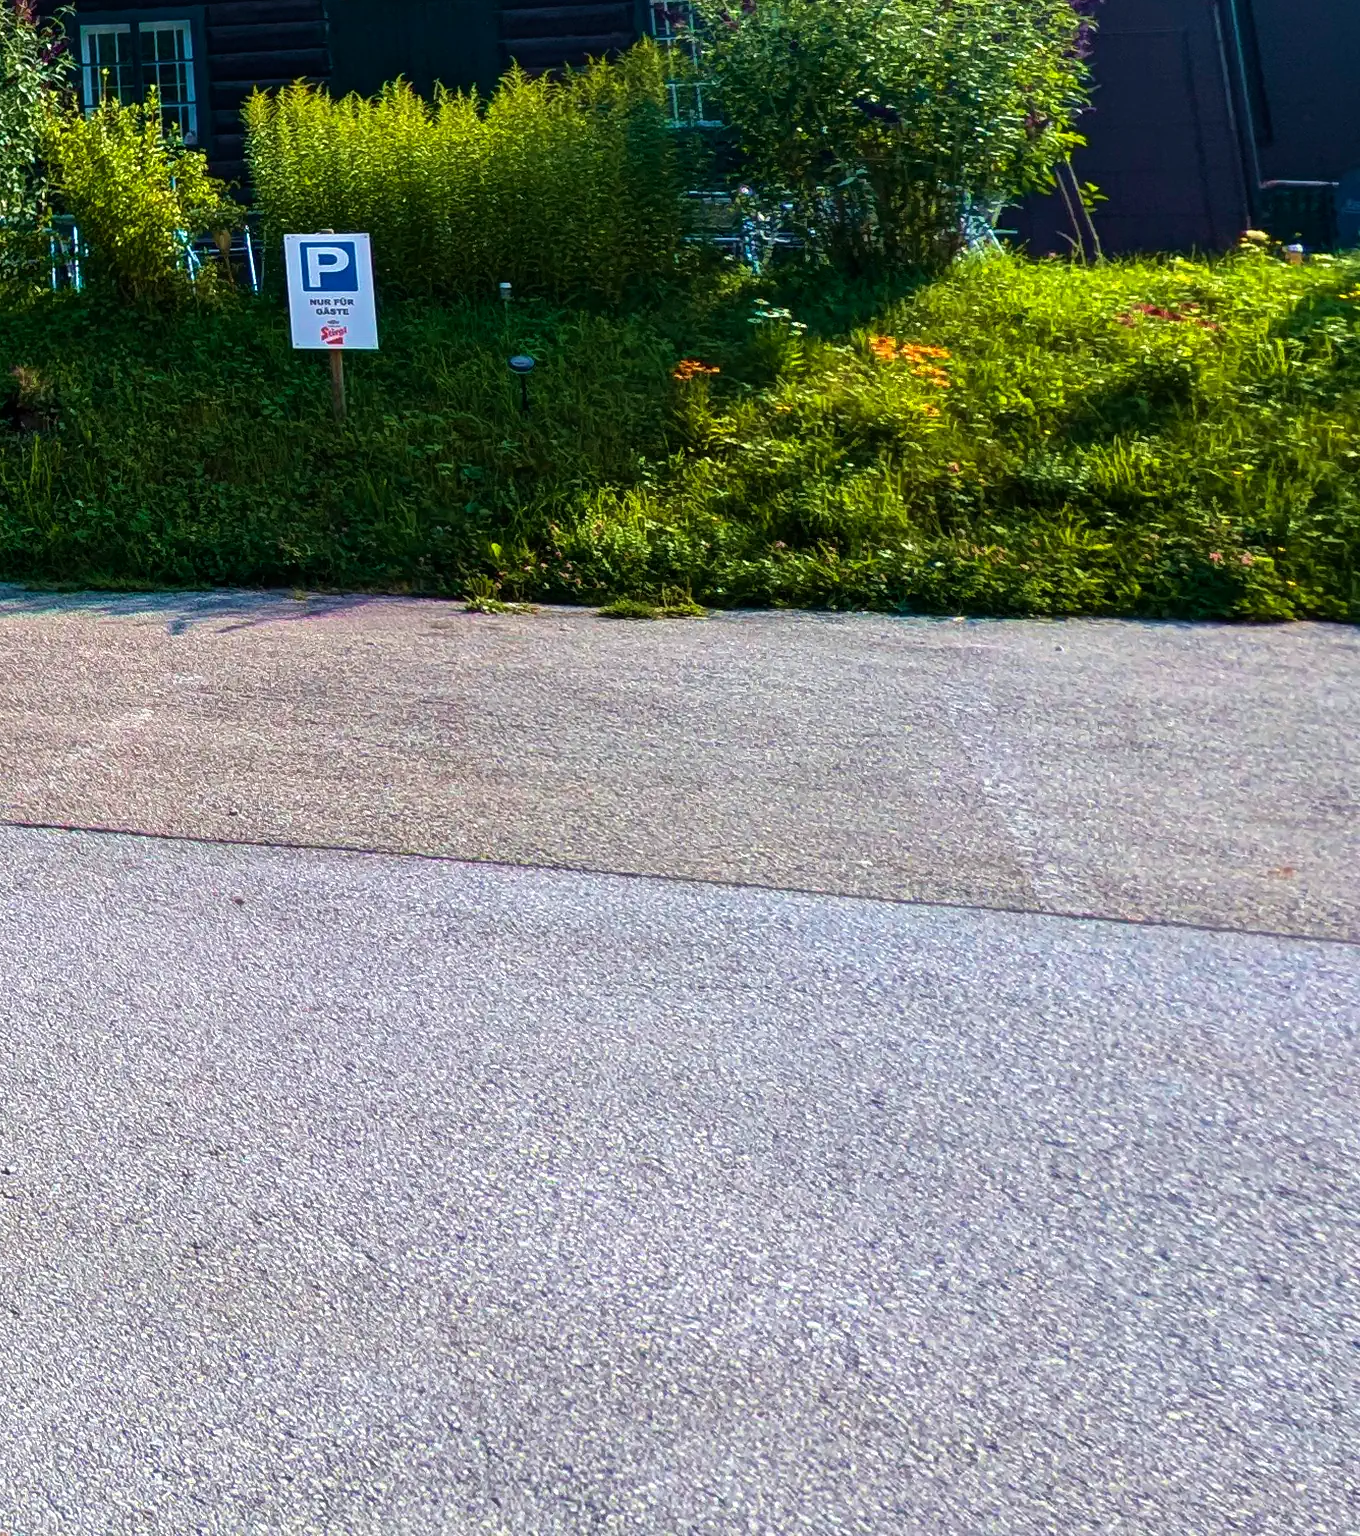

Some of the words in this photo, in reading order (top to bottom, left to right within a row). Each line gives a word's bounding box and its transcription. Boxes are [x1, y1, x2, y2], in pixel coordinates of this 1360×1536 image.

[306, 246, 350, 288] P
[309, 298, 332, 306] NUR
[333, 296, 354, 306] FÜR
